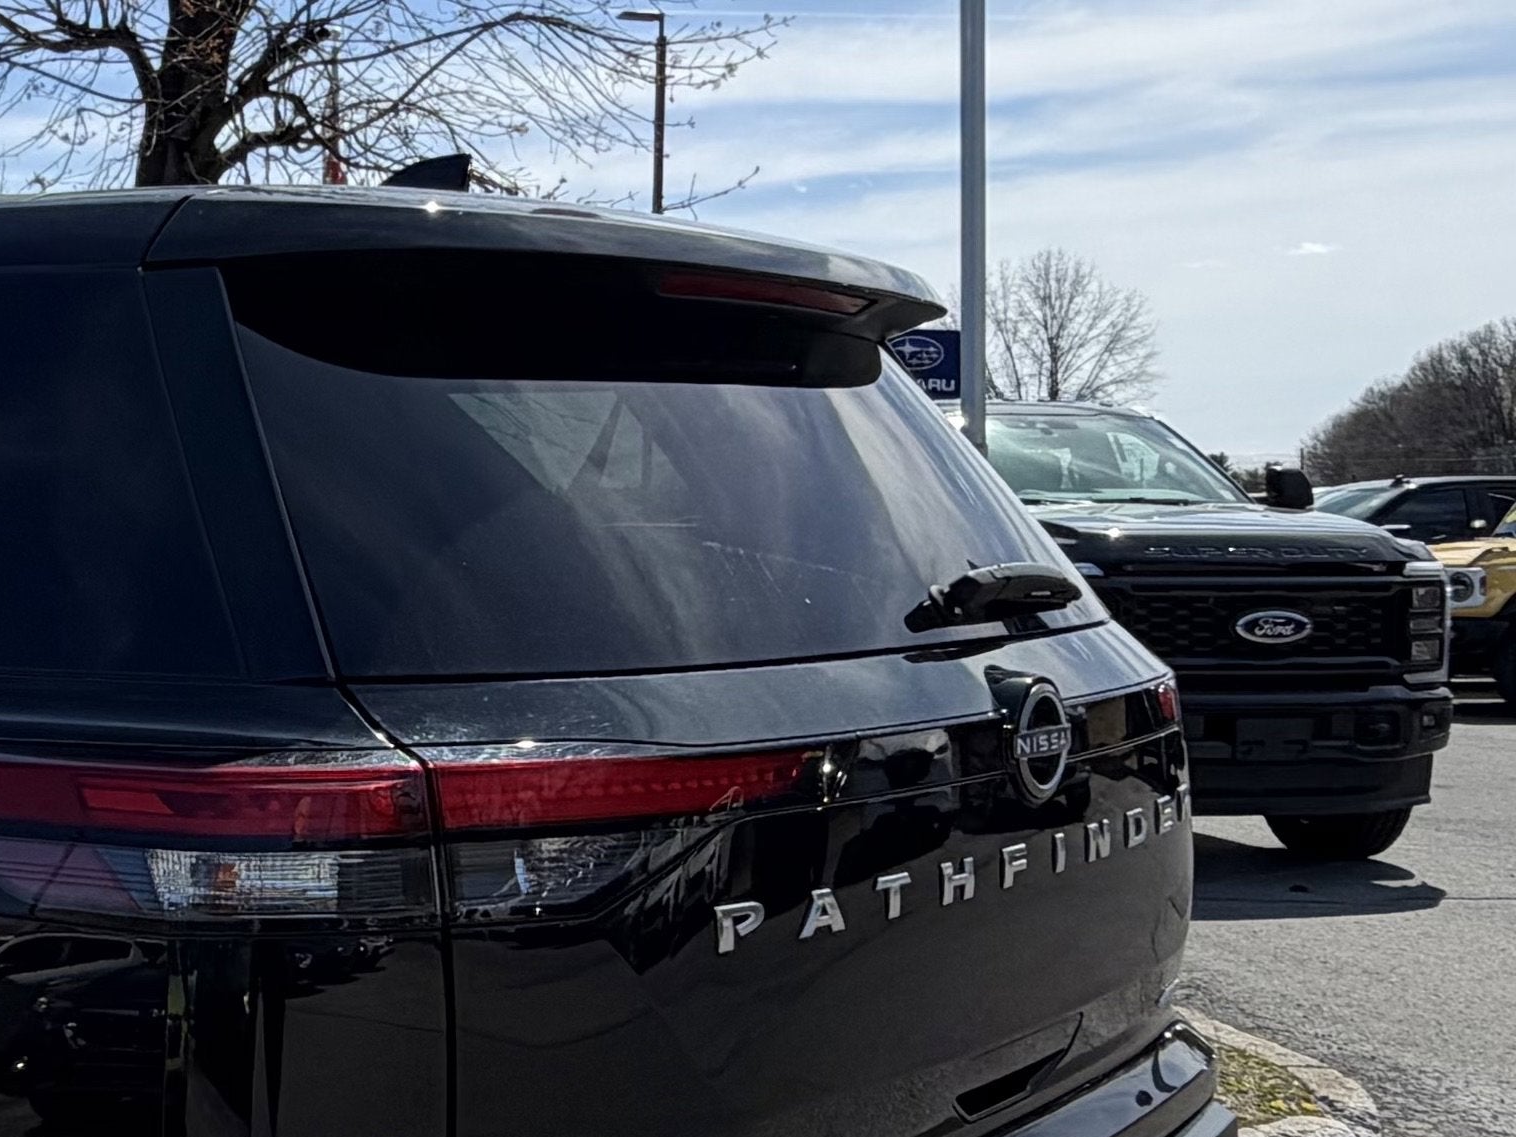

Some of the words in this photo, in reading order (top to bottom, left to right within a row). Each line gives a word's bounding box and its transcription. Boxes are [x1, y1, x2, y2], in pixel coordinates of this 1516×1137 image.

[916, 378, 956, 392] ARU
[1144, 546, 1275, 559] SUPER
[1281, 546, 1368, 559] DUTY
[1253, 617, 1296, 637] Ford
[1016, 731, 1068, 755] NISSA
